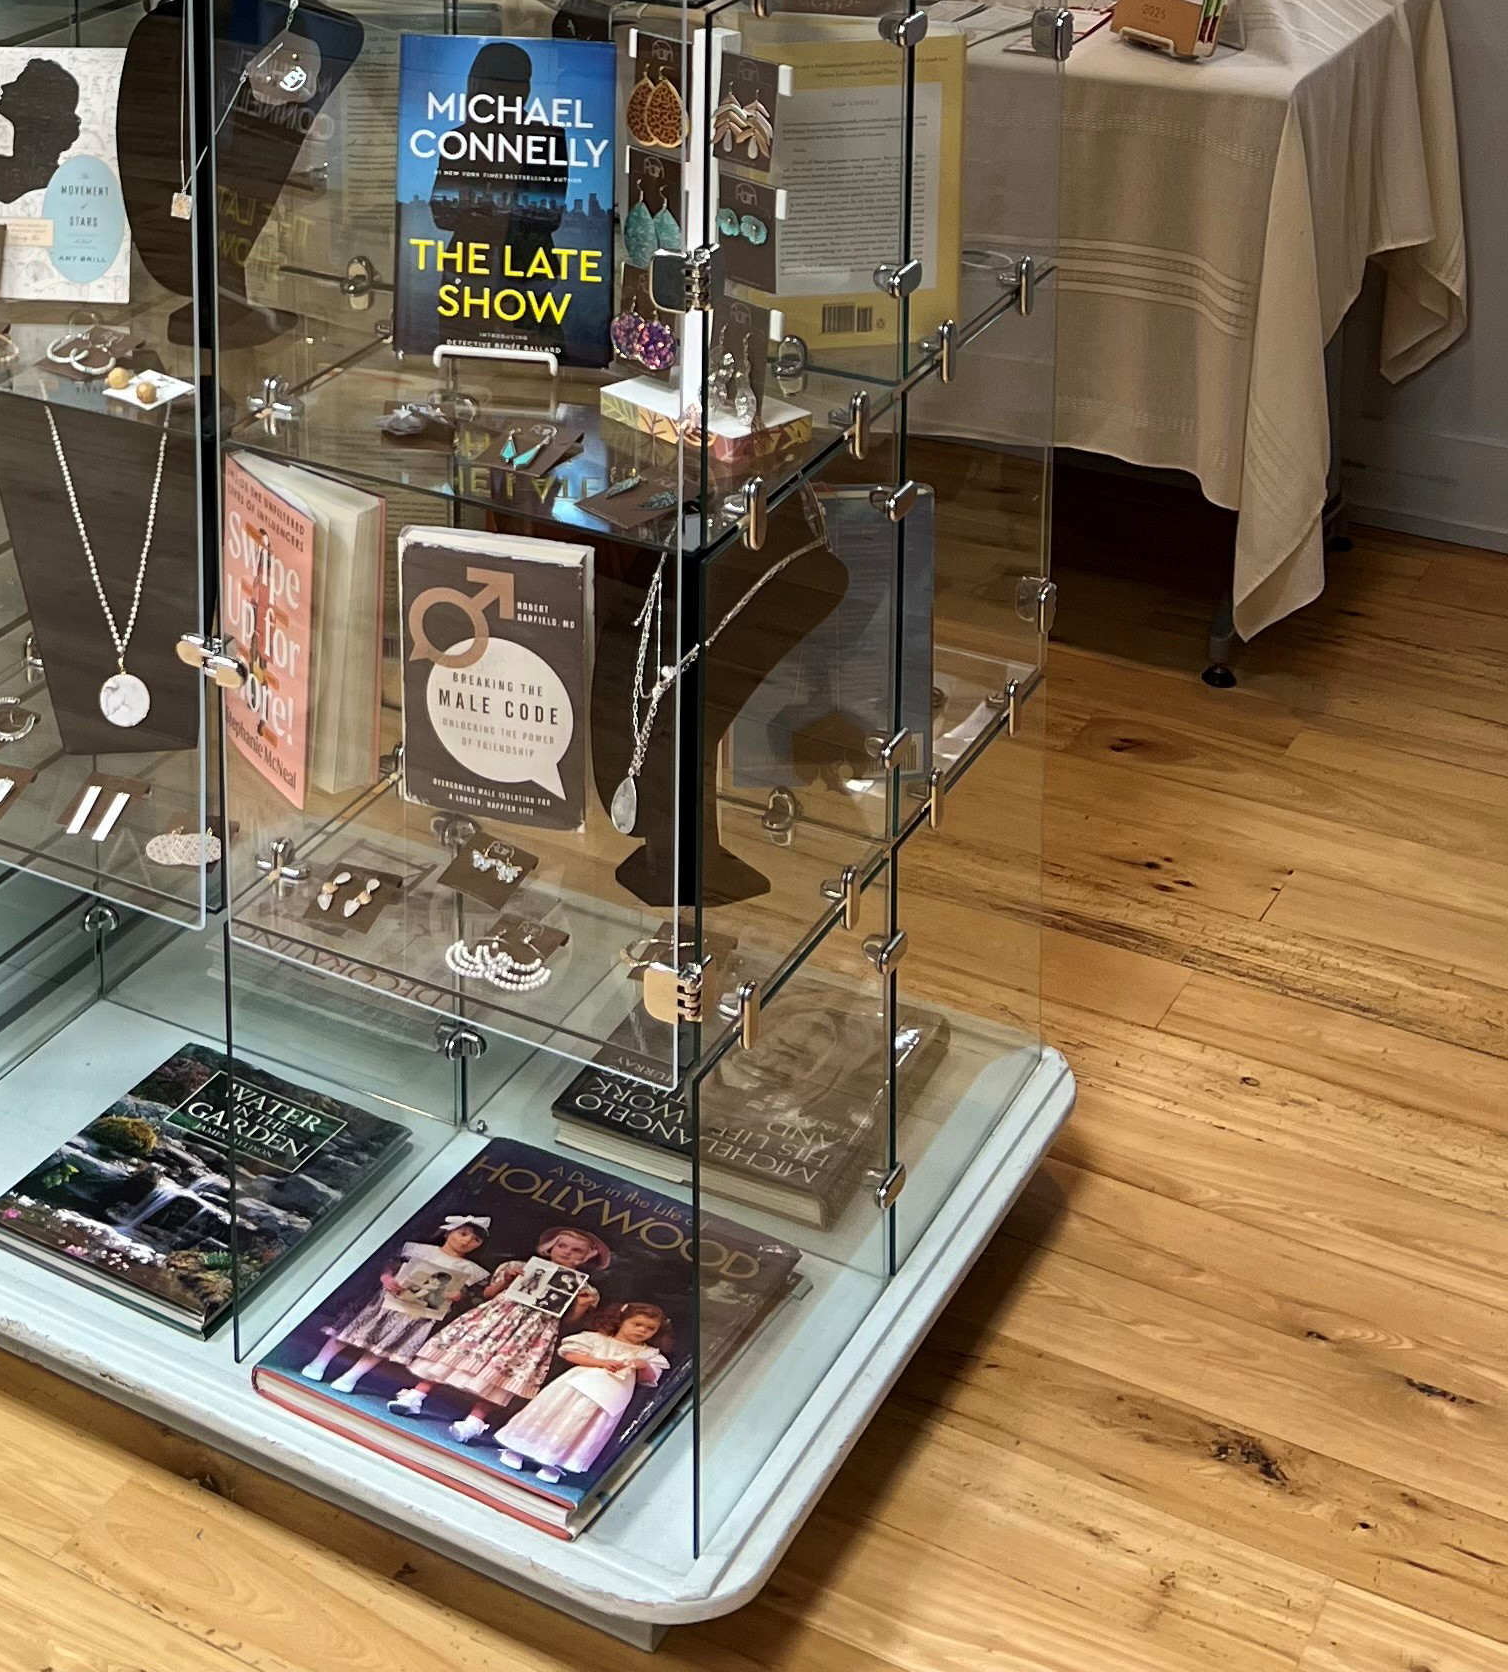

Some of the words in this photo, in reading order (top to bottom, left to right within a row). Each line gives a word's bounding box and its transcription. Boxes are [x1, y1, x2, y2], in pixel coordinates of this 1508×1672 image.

[427, 91, 594, 129] MICHAEL
[409, 128, 609, 169] CONNELLY
[61, 185, 109, 197] MOVEMENT
[69, 216, 98, 228] STARS
[409, 238, 490, 275] THE
[504, 245, 603, 283] LATE
[436, 284, 572, 325] SHOW
[228, 511, 301, 610] Swipe
[227, 573, 254, 645] Up
[263, 607, 301, 678] for
[439, 688, 490, 714] MALE
[505, 701, 558, 725] CODE
[453, 672, 513, 693] BREAKING
[521, 683, 543, 697] THE
[226, 1083, 322, 1133] WATER
[590, 1076, 685, 1124] WORK
[188, 1102, 310, 1157] GARDEN
[548, 1166, 565, 1177] A
[567, 1170, 599, 1193] Day
[605, 1183, 621, 1199] in
[624, 1188, 651, 1210] the
[654, 1202, 681, 1221] Life
[467, 1154, 760, 1280] HOLLYWOOD
